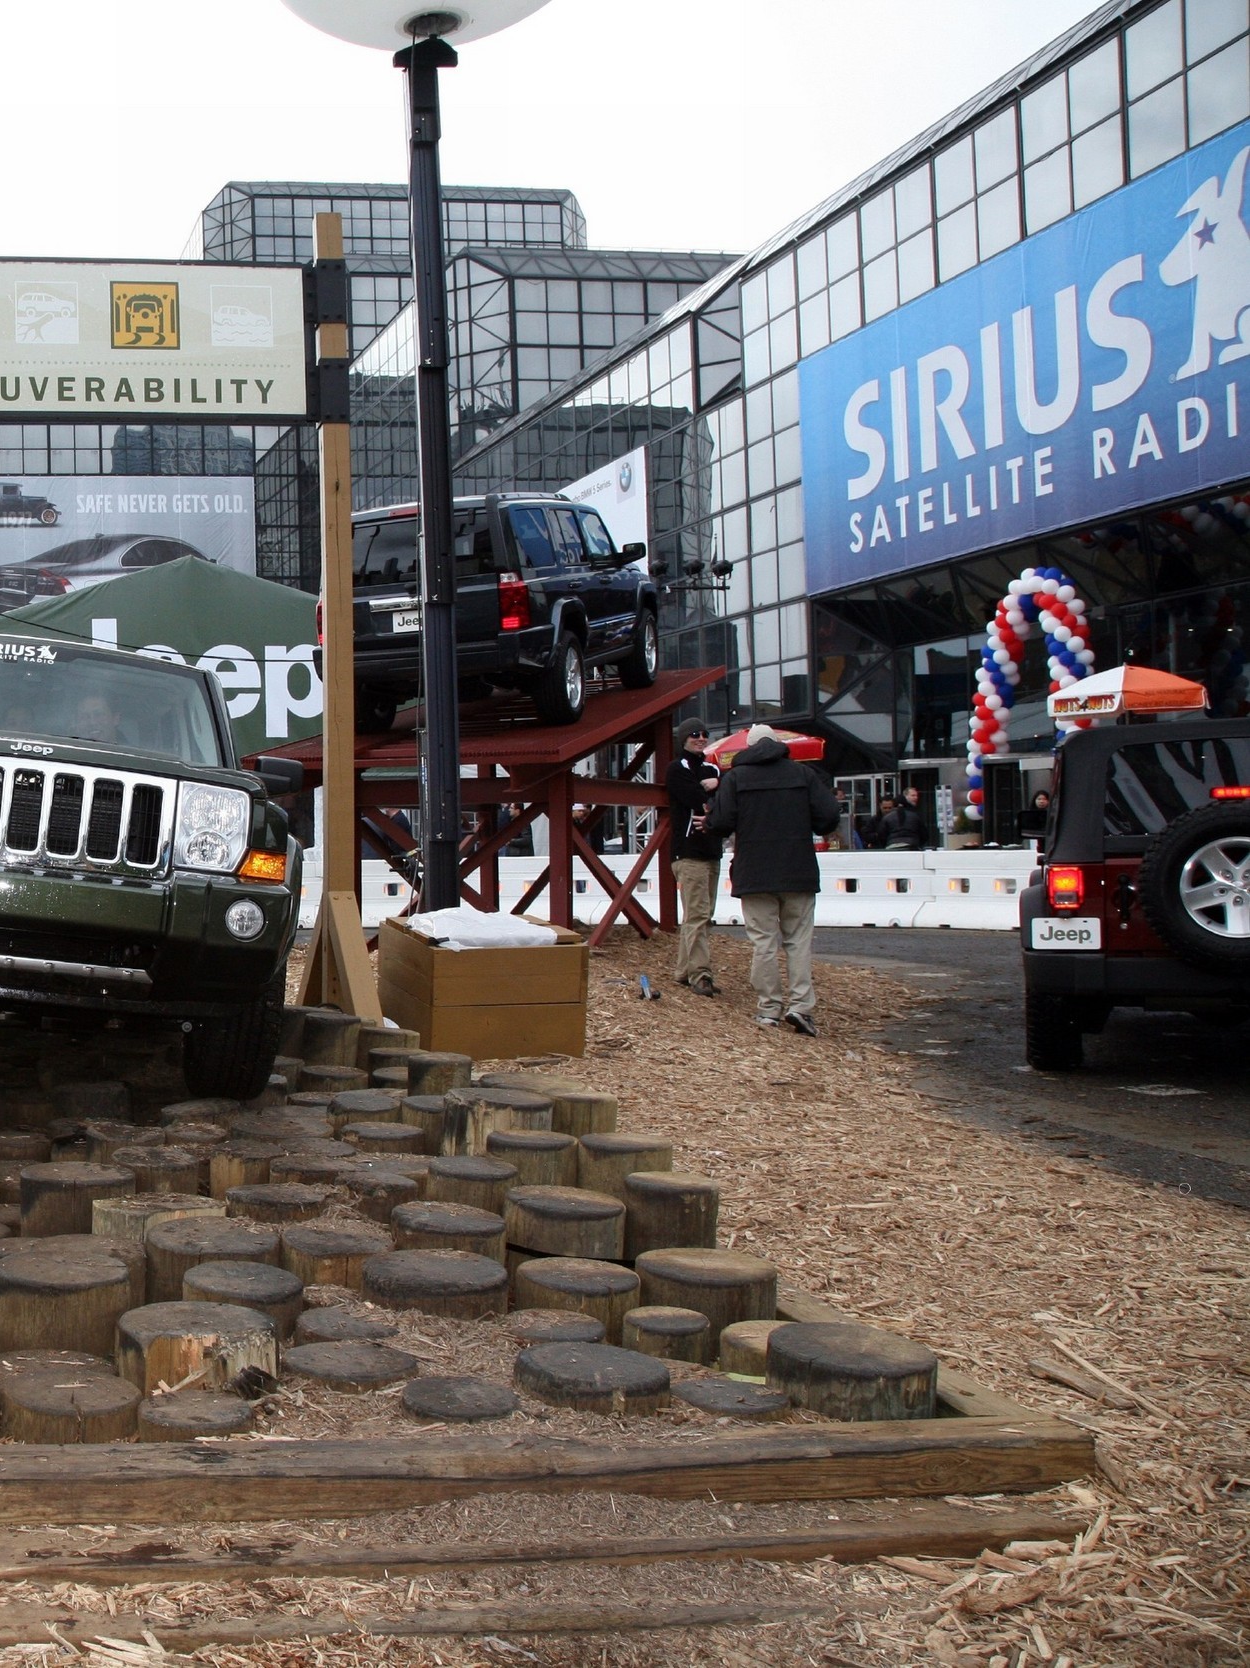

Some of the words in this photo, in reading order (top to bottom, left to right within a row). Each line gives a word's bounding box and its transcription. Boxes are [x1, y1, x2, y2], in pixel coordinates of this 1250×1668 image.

[843, 253, 1152, 501] SIRIUS
[849, 445, 1054, 554] SATELLITE
[1093, 381, 1239, 480] RADI
[76, 494, 113, 514] SAFE
[117, 494, 168, 514] NEVER
[172, 494, 210, 514] GETS
[213, 494, 248, 514] OLD.
[397, 616, 422, 627] Jee
[23, 656, 55, 665] RADIO
[10, 742, 54, 756] Jeep
[1039, 925, 1092, 944] Jeep
